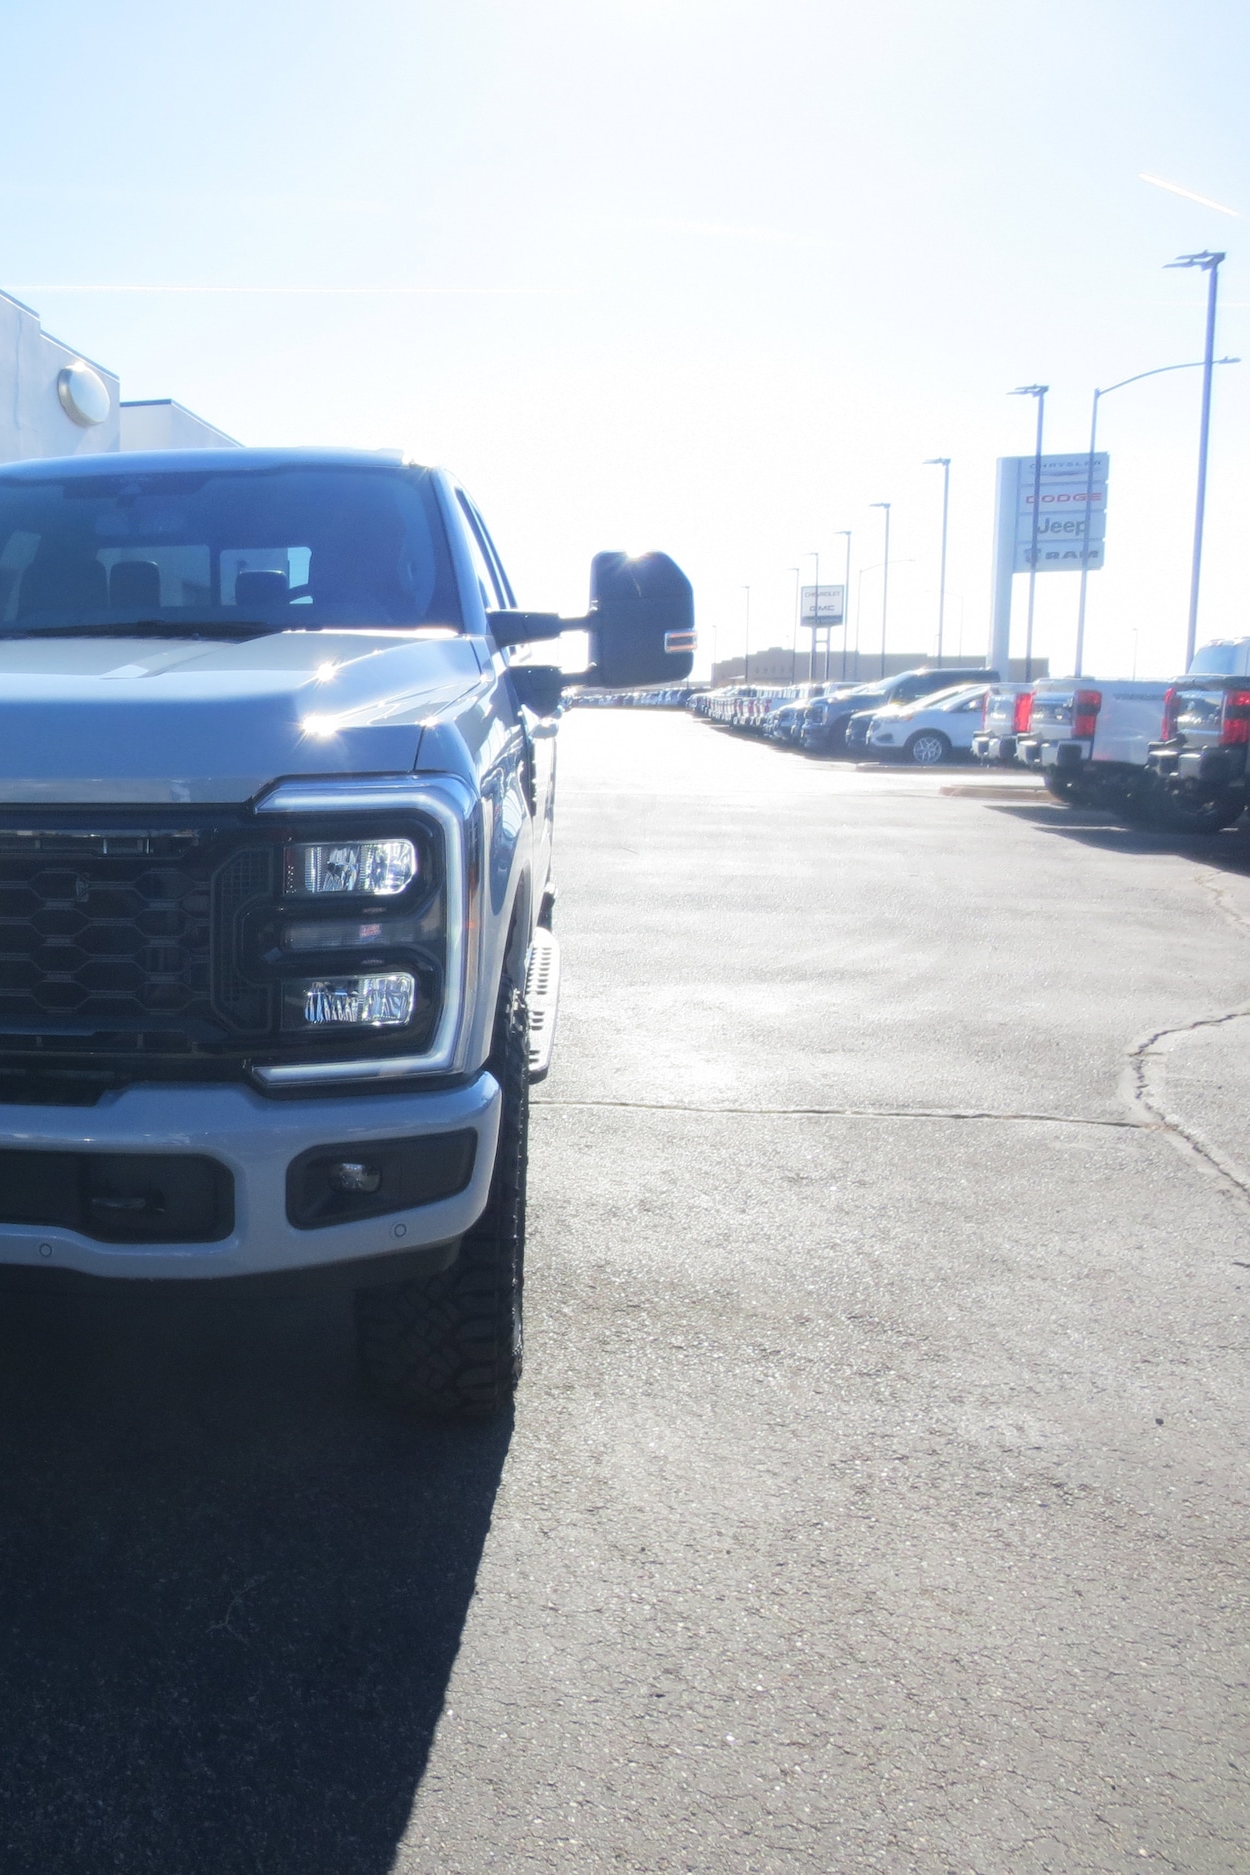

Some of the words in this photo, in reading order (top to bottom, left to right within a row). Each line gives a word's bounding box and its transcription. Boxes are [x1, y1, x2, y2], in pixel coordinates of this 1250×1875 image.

[1025, 492, 1103, 504] DODGE
[1036, 517, 1088, 537] Jeep
[1044, 550, 1099, 560] RAM
